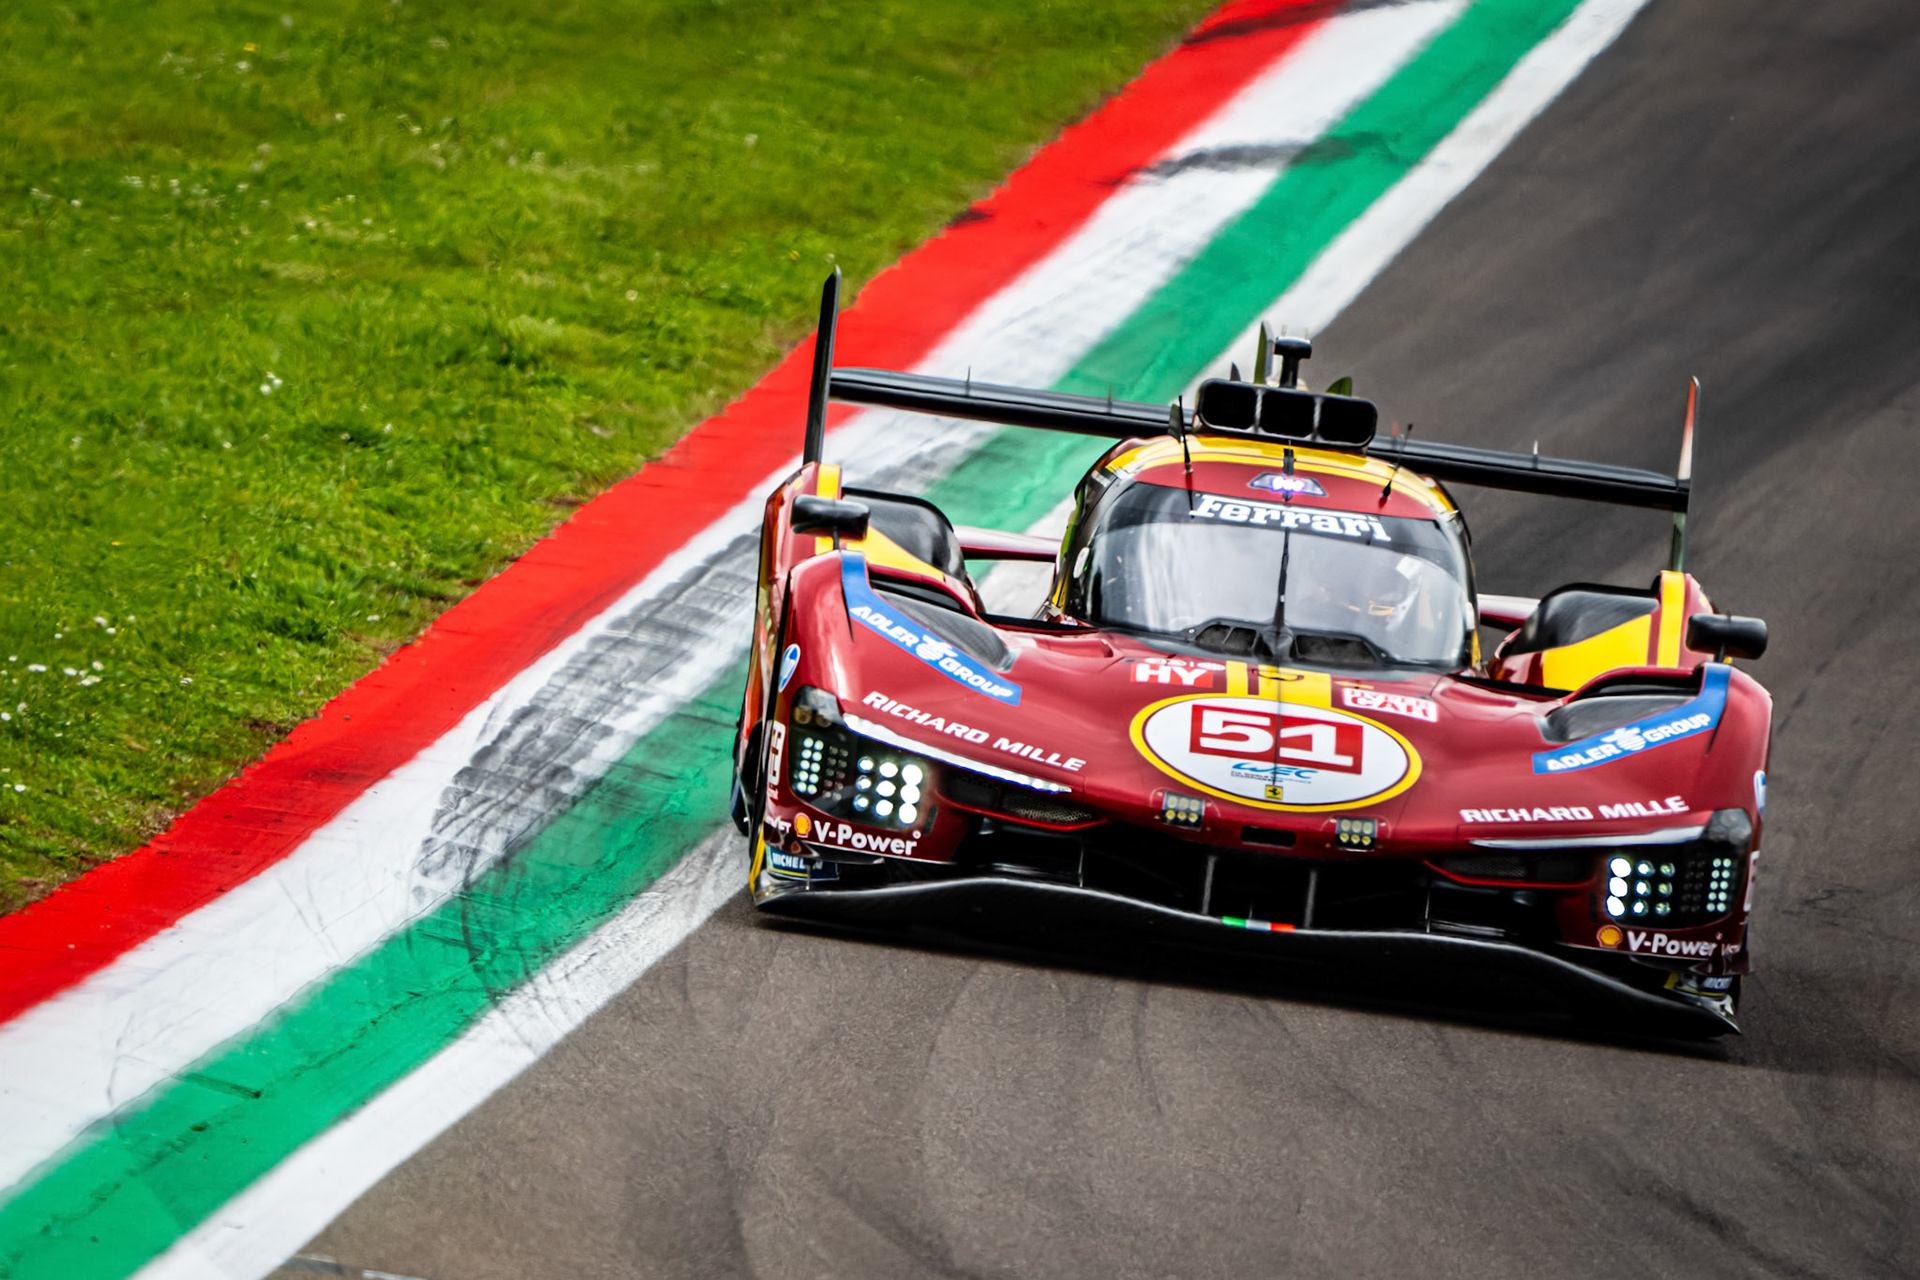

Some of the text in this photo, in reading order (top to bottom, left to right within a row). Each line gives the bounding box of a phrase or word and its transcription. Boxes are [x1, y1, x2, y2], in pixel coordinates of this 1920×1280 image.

[1189, 493, 1391, 542] Ferrari
[849, 606, 1014, 697] ADLER GROUP
[1136, 663, 1207, 685] HY
[862, 691, 1087, 772] RICHARD MILLE
[1200, 710, 1354, 767] 51
[1546, 713, 1711, 771] ADLER GROUP
[1459, 796, 1689, 823] RICHARD MILLE
[814, 820, 918, 856] V-Power
[1627, 930, 1718, 957] V-Power
